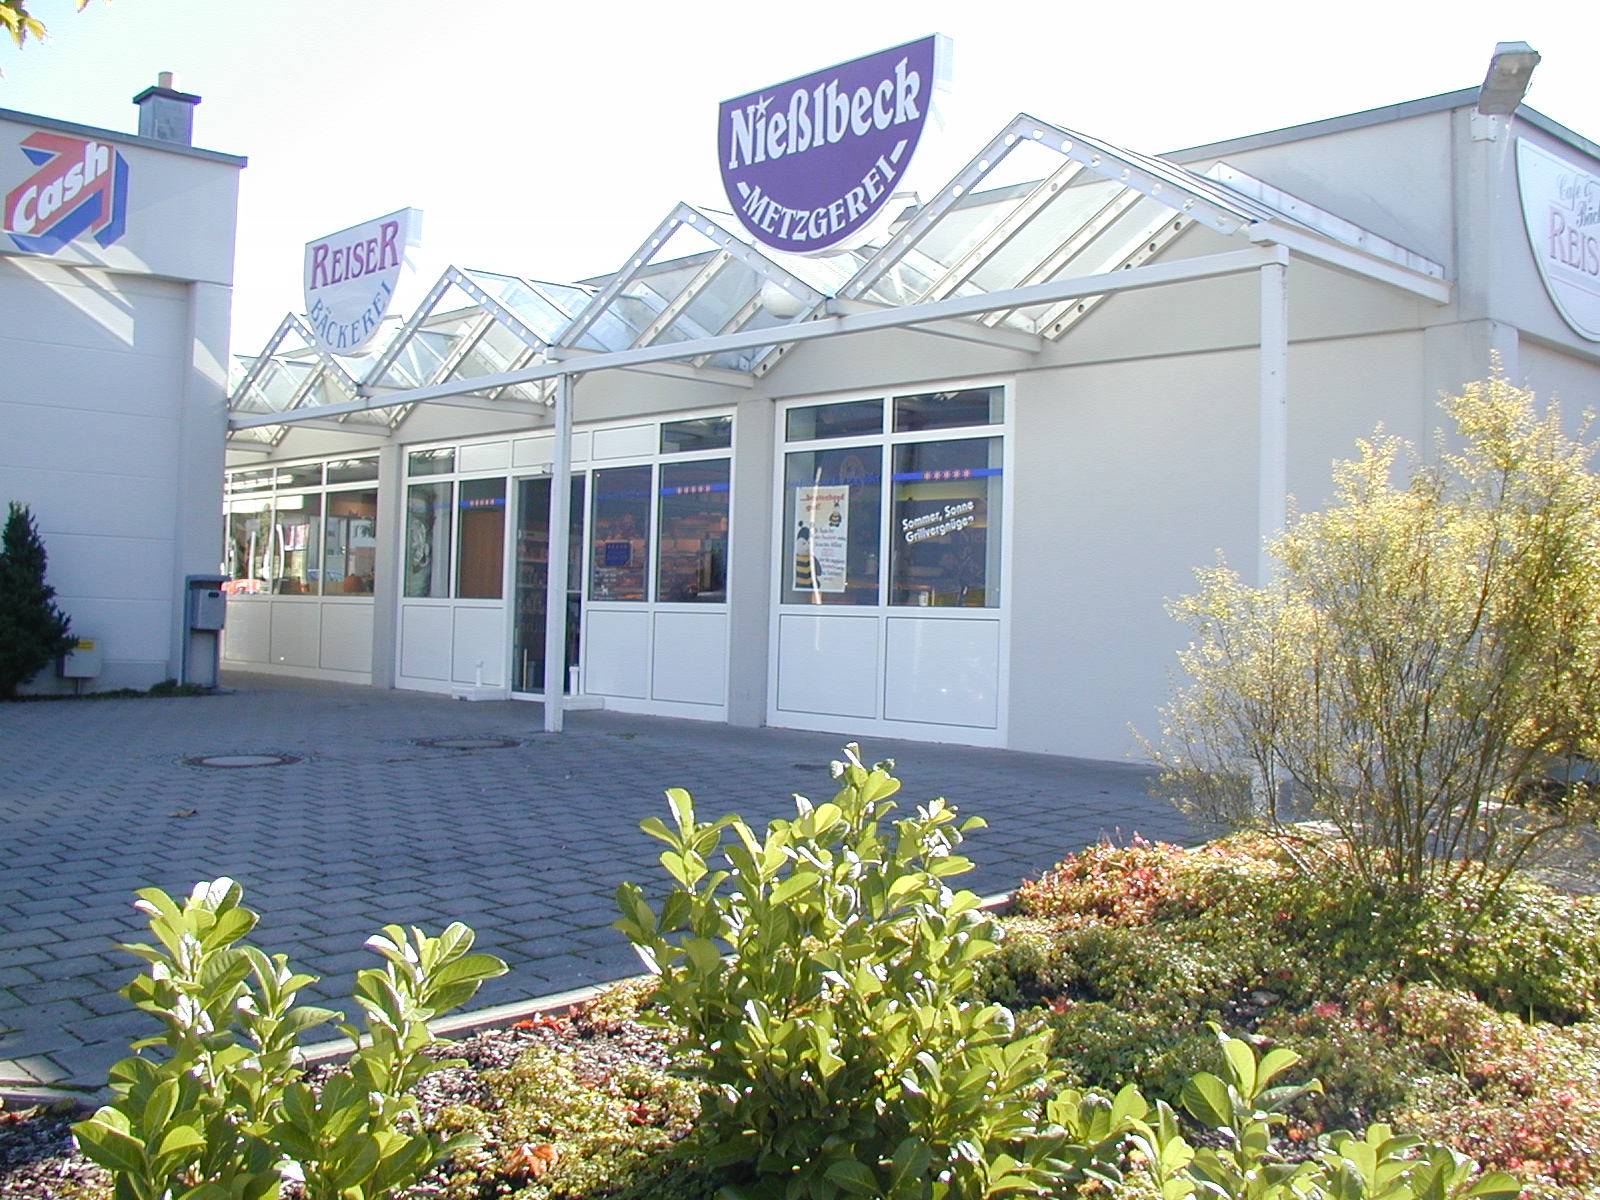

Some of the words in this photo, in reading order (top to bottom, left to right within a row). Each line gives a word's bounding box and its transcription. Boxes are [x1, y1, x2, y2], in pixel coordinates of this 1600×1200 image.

[729, 57, 920, 169] Nießlbeck
[13, 142, 109, 233] Cash
[310, 220, 400, 290] REISER
[311, 280, 392, 348] BÄCKEREI
[944, 500, 974, 518] Sonne
